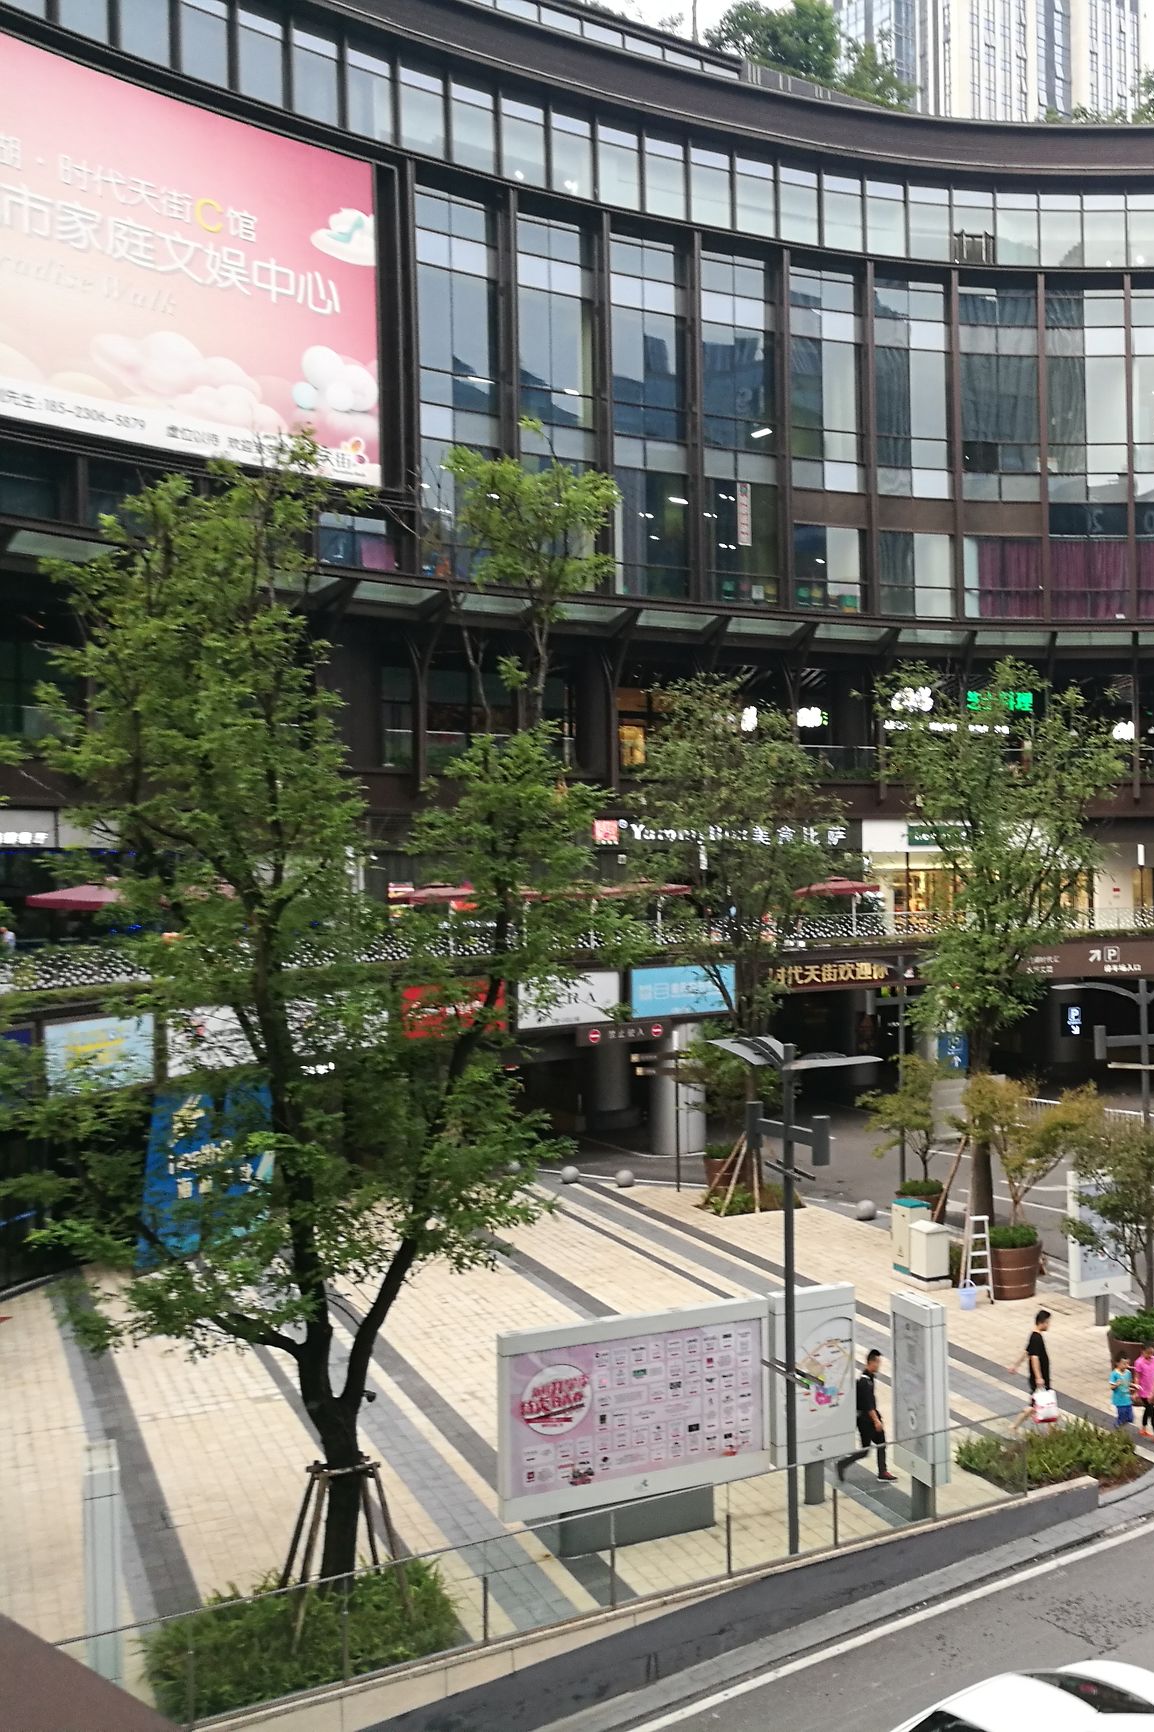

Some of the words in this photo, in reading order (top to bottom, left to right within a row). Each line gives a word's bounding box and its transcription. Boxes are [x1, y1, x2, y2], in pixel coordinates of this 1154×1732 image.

[0, 180, 341, 315] 市家庭文娱中心
